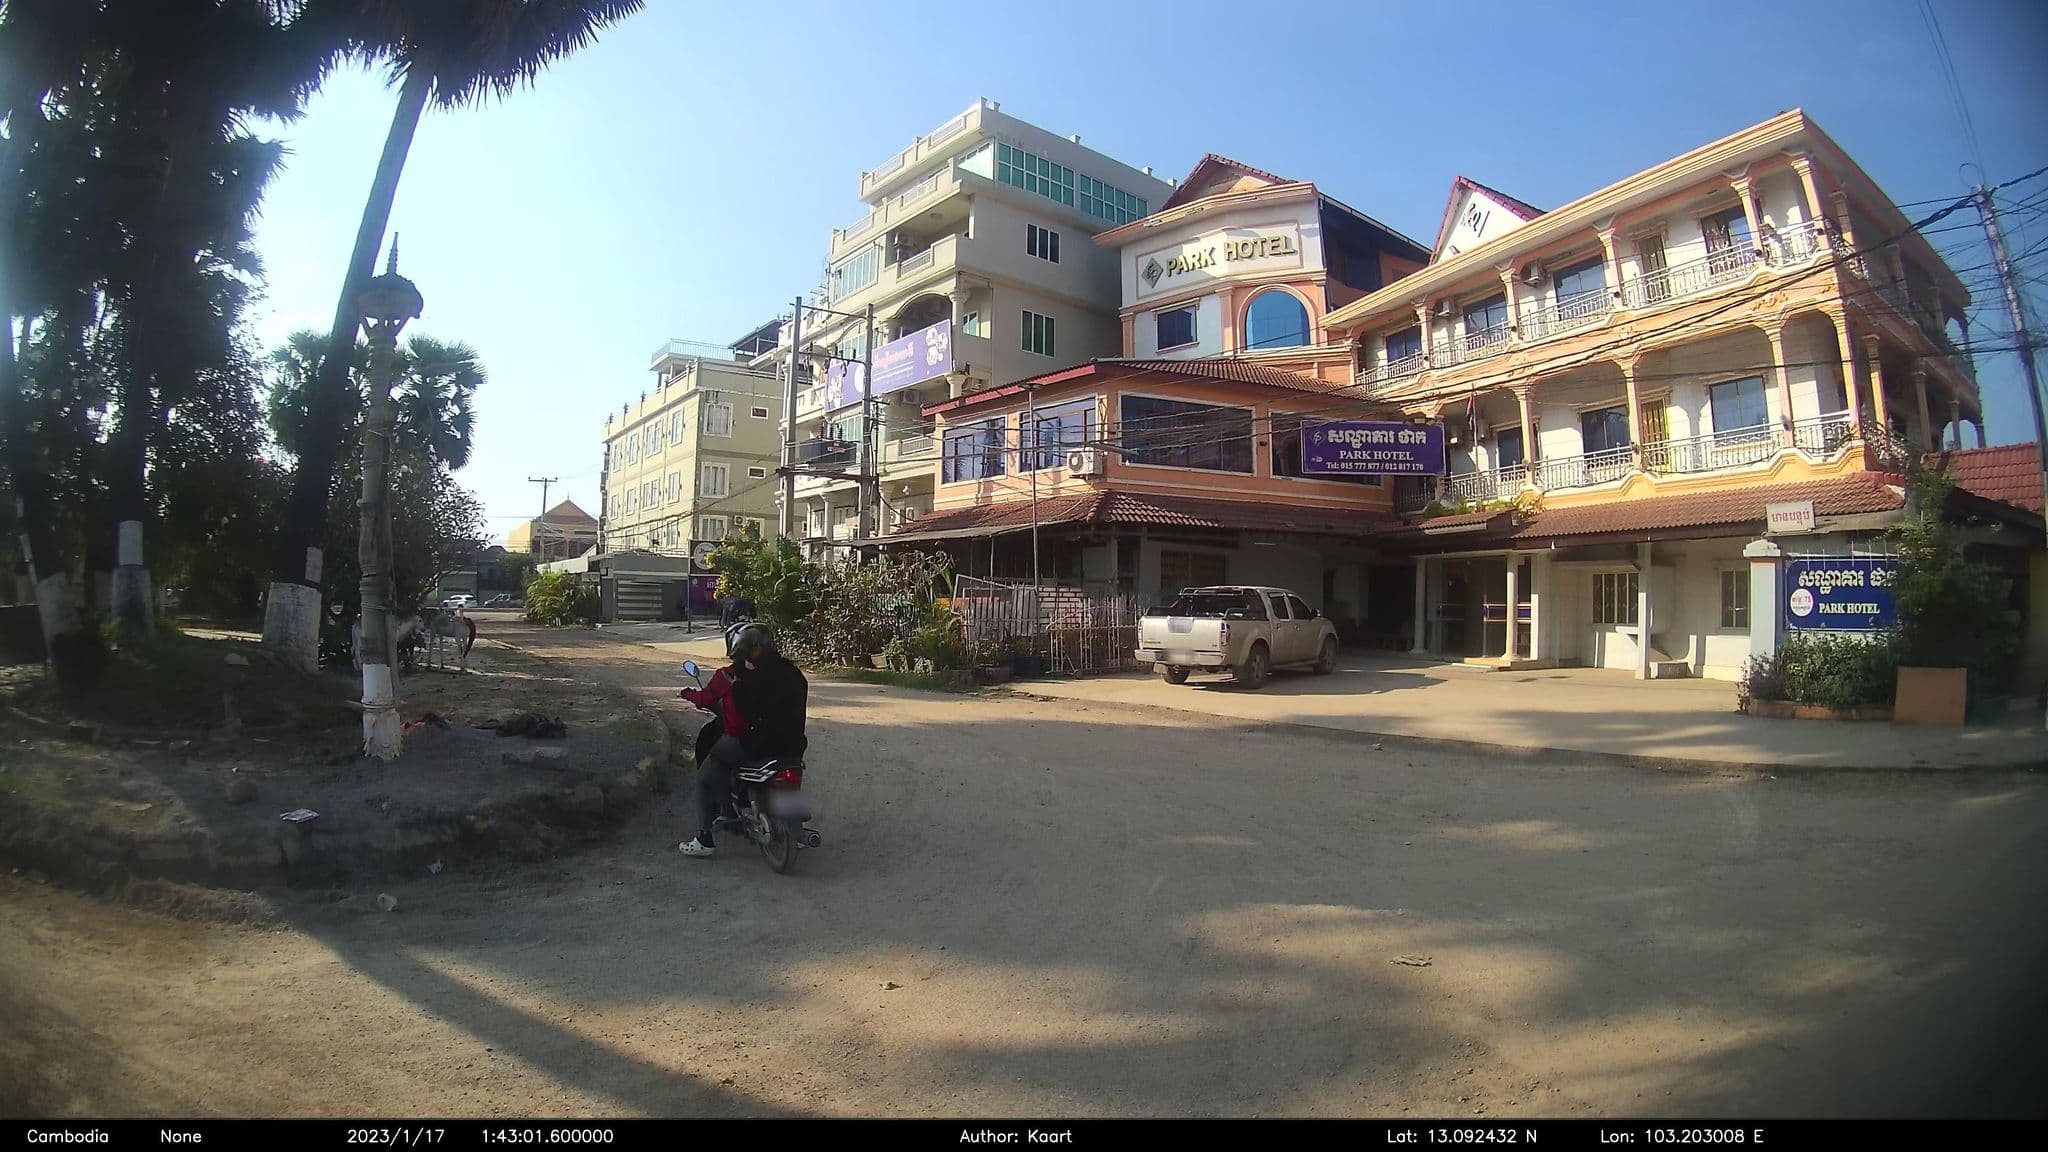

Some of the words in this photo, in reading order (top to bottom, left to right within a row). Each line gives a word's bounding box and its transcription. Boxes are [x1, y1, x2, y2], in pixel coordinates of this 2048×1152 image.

[1166, 246, 1216, 278] PARK
[1224, 234, 1298, 262] HOTEL
[1340, 450, 1370, 460] PARK
[1374, 450, 1414, 461] HOTEL
[1354, 462, 1367, 470] 777
[1818, 603, 1845, 614] PARK
[1846, 603, 1880, 614] HOTEL
